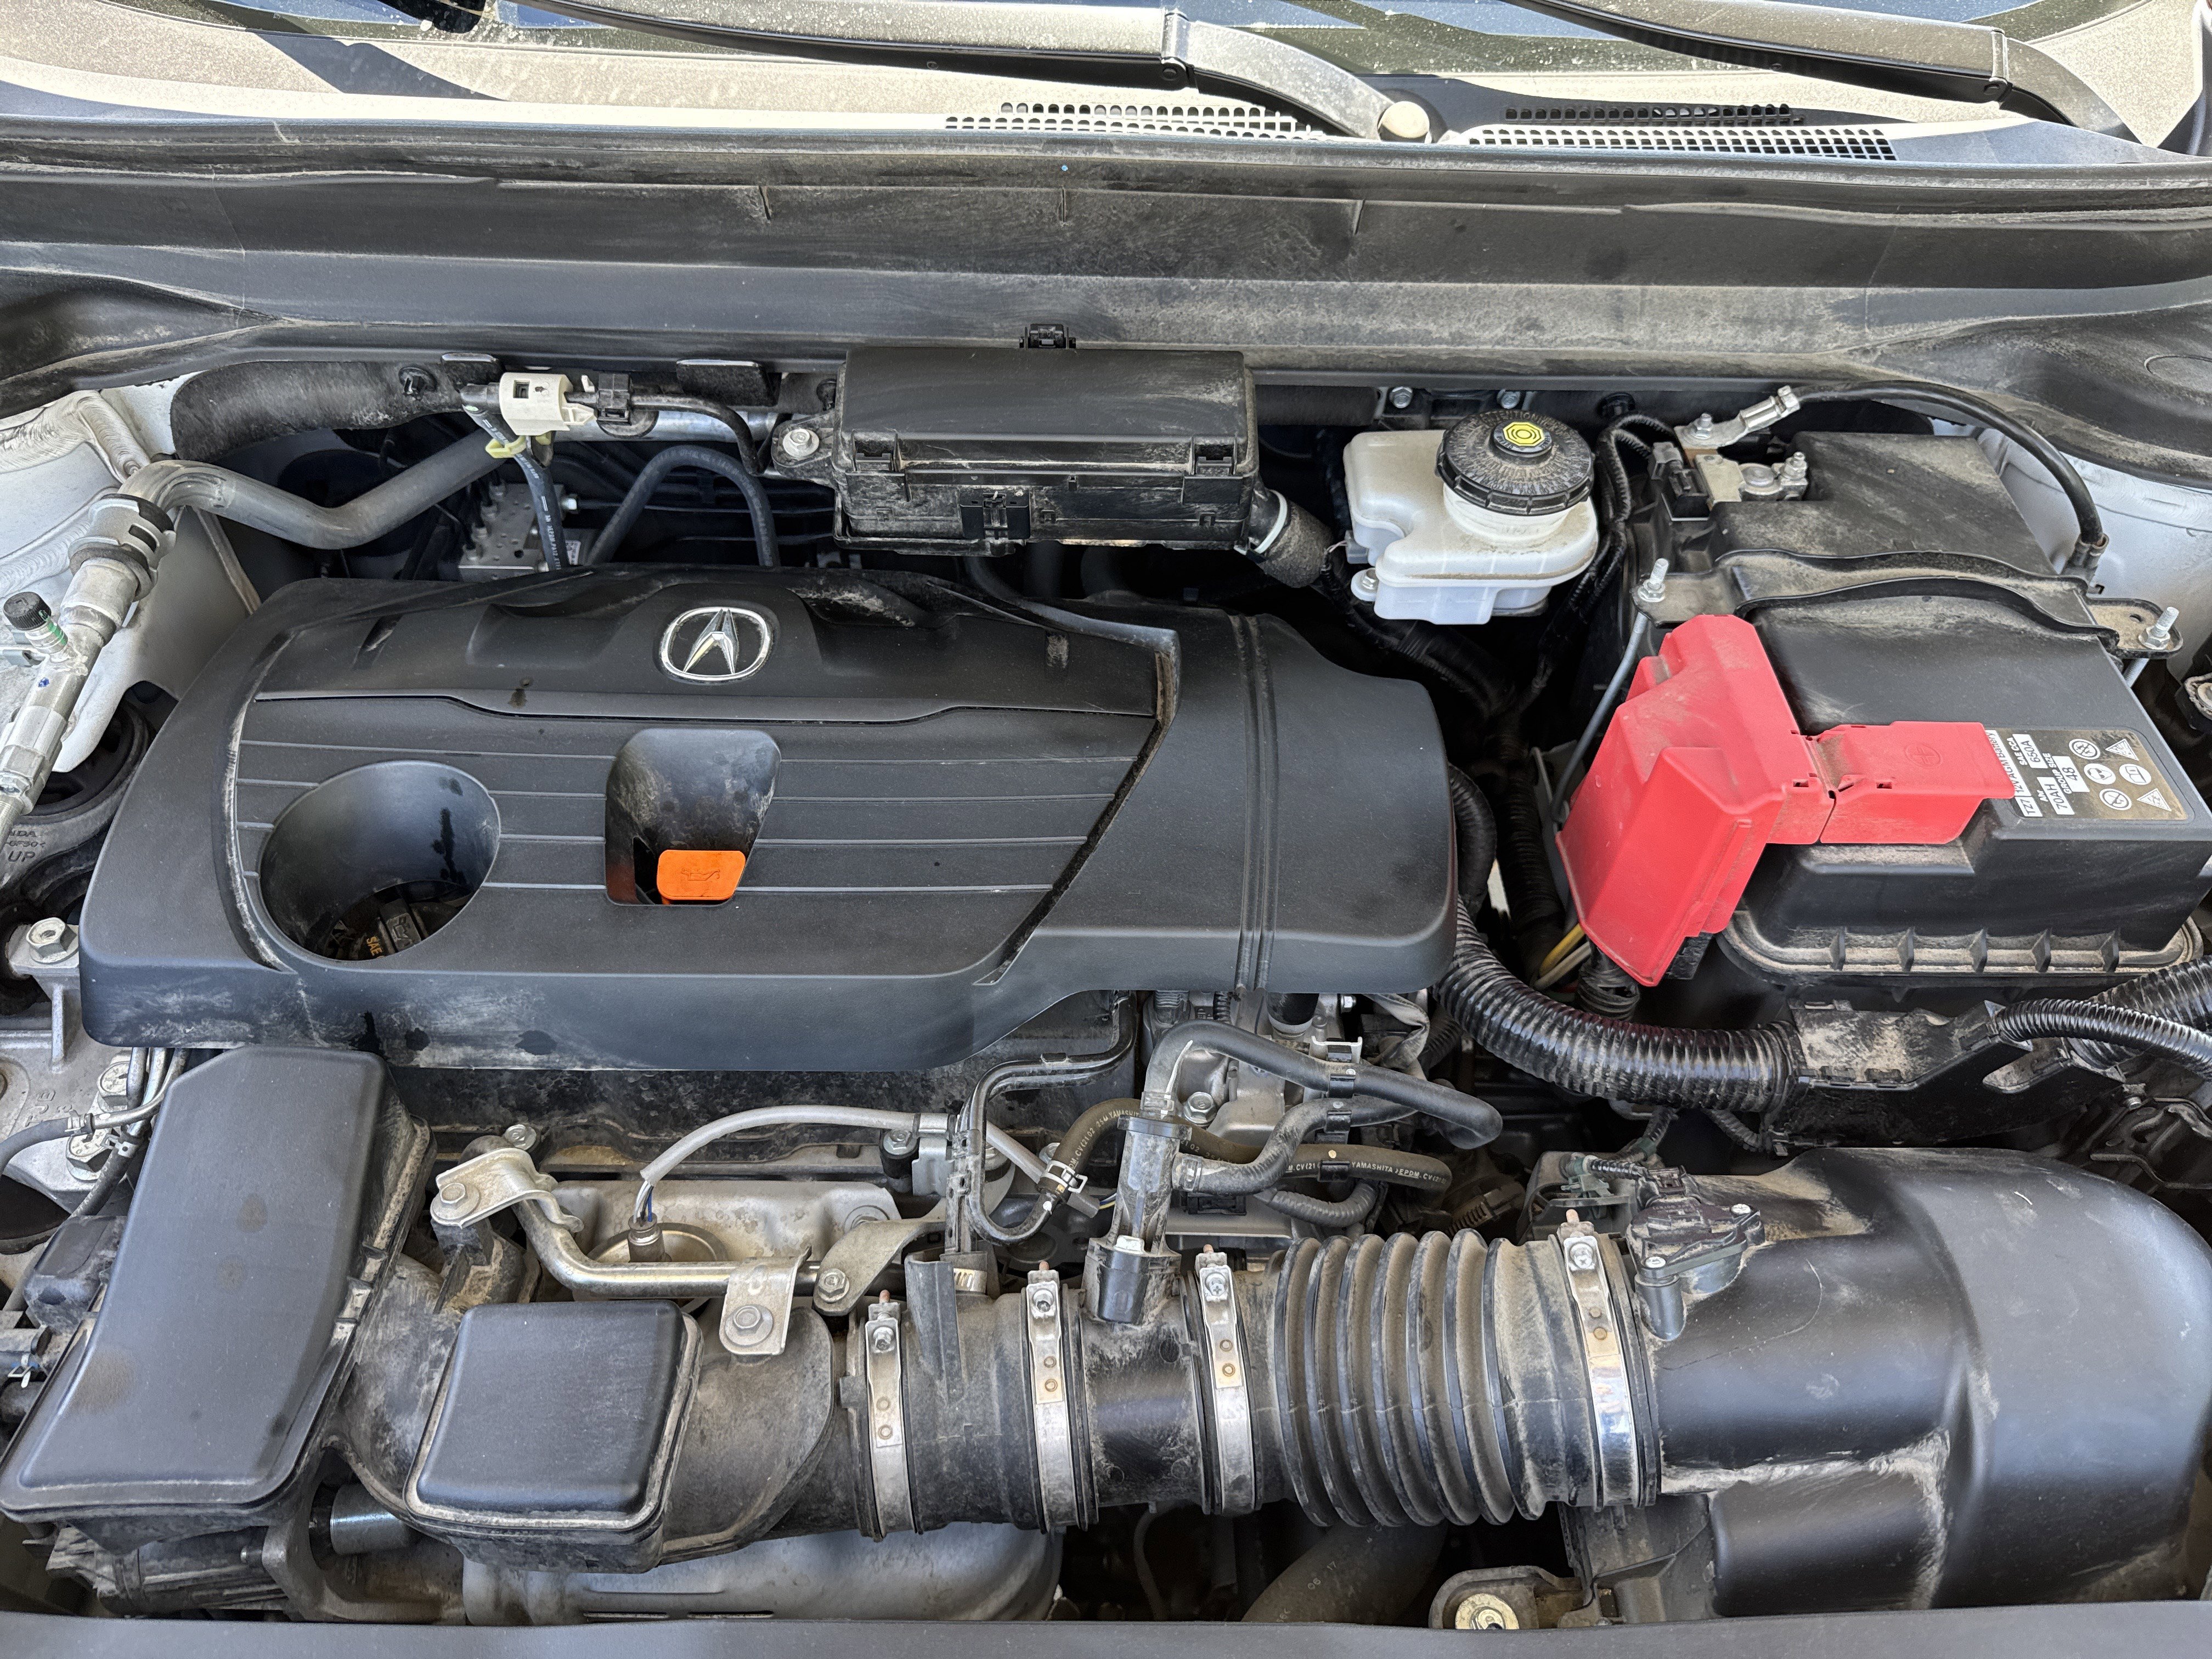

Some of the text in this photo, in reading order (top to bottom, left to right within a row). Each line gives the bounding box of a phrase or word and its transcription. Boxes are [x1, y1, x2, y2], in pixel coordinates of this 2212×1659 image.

[2006, 737, 2028, 766] SAE CCA
[2020, 740, 2041, 763] 650A
[2042, 753, 2073, 794] GROUP SIZE
[2061, 767, 2078, 781] 48
[2044, 783, 2068, 810] 70AH
[2020, 798, 2036, 815] TZ7
[7, 850, 36, 862] UP
[366, 936, 383, 956] SAE
[1108, 1109, 1139, 1119] YAMASHIT
[1351, 1160, 1393, 1172] YAMASHITA
